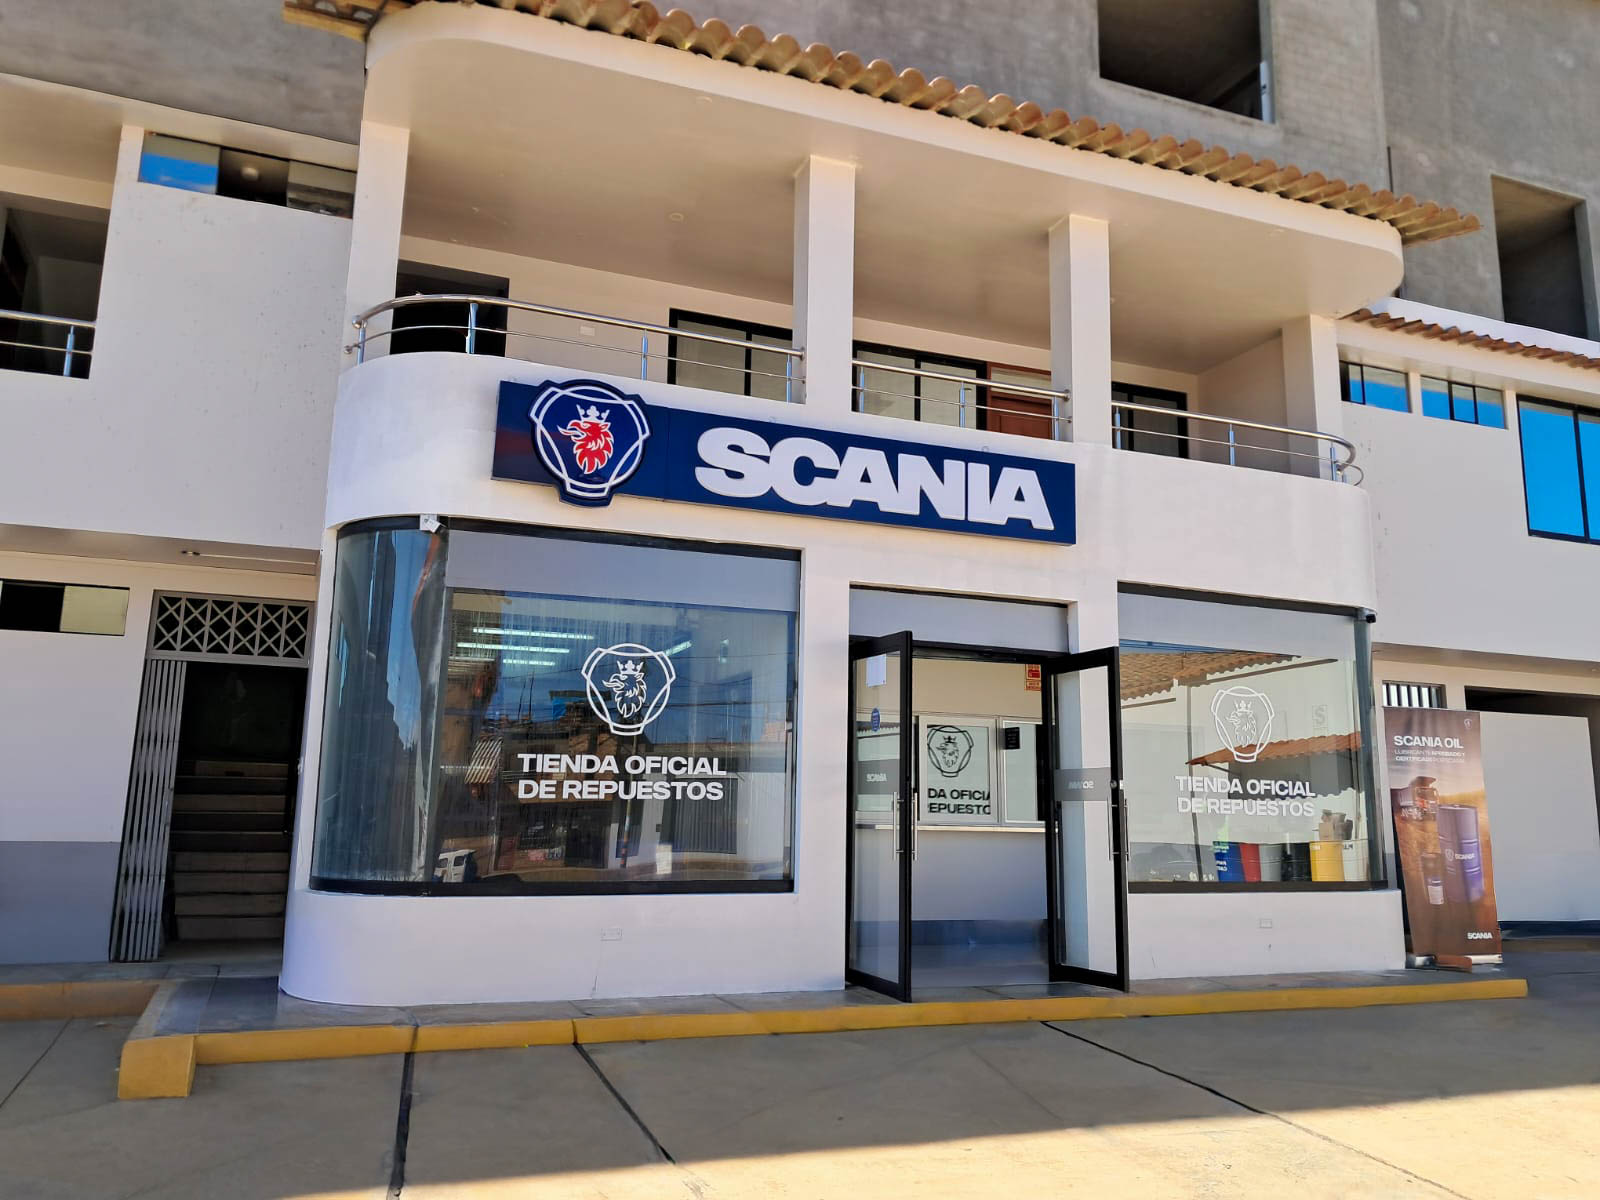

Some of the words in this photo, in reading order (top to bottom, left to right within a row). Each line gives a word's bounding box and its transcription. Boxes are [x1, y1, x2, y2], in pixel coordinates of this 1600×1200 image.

[694, 426, 1054, 530] SCANIA
[1393, 735, 1443, 747] SCANIA
[1444, 737, 1464, 749] OIL
[517, 753, 620, 774] TIENDA
[624, 755, 727, 776] OFICIAL
[518, 779, 557, 799] DE
[562, 780, 724, 801] REPUESTOS
[928, 788, 947, 799] DA
[1175, 775, 1244, 794] TIENDA
[1246, 779, 1316, 797] OFICIAL
[1177, 797, 1203, 813] DE
[1207, 798, 1315, 817] REPUESTOS
[1467, 932, 1493, 940] SCANIA
